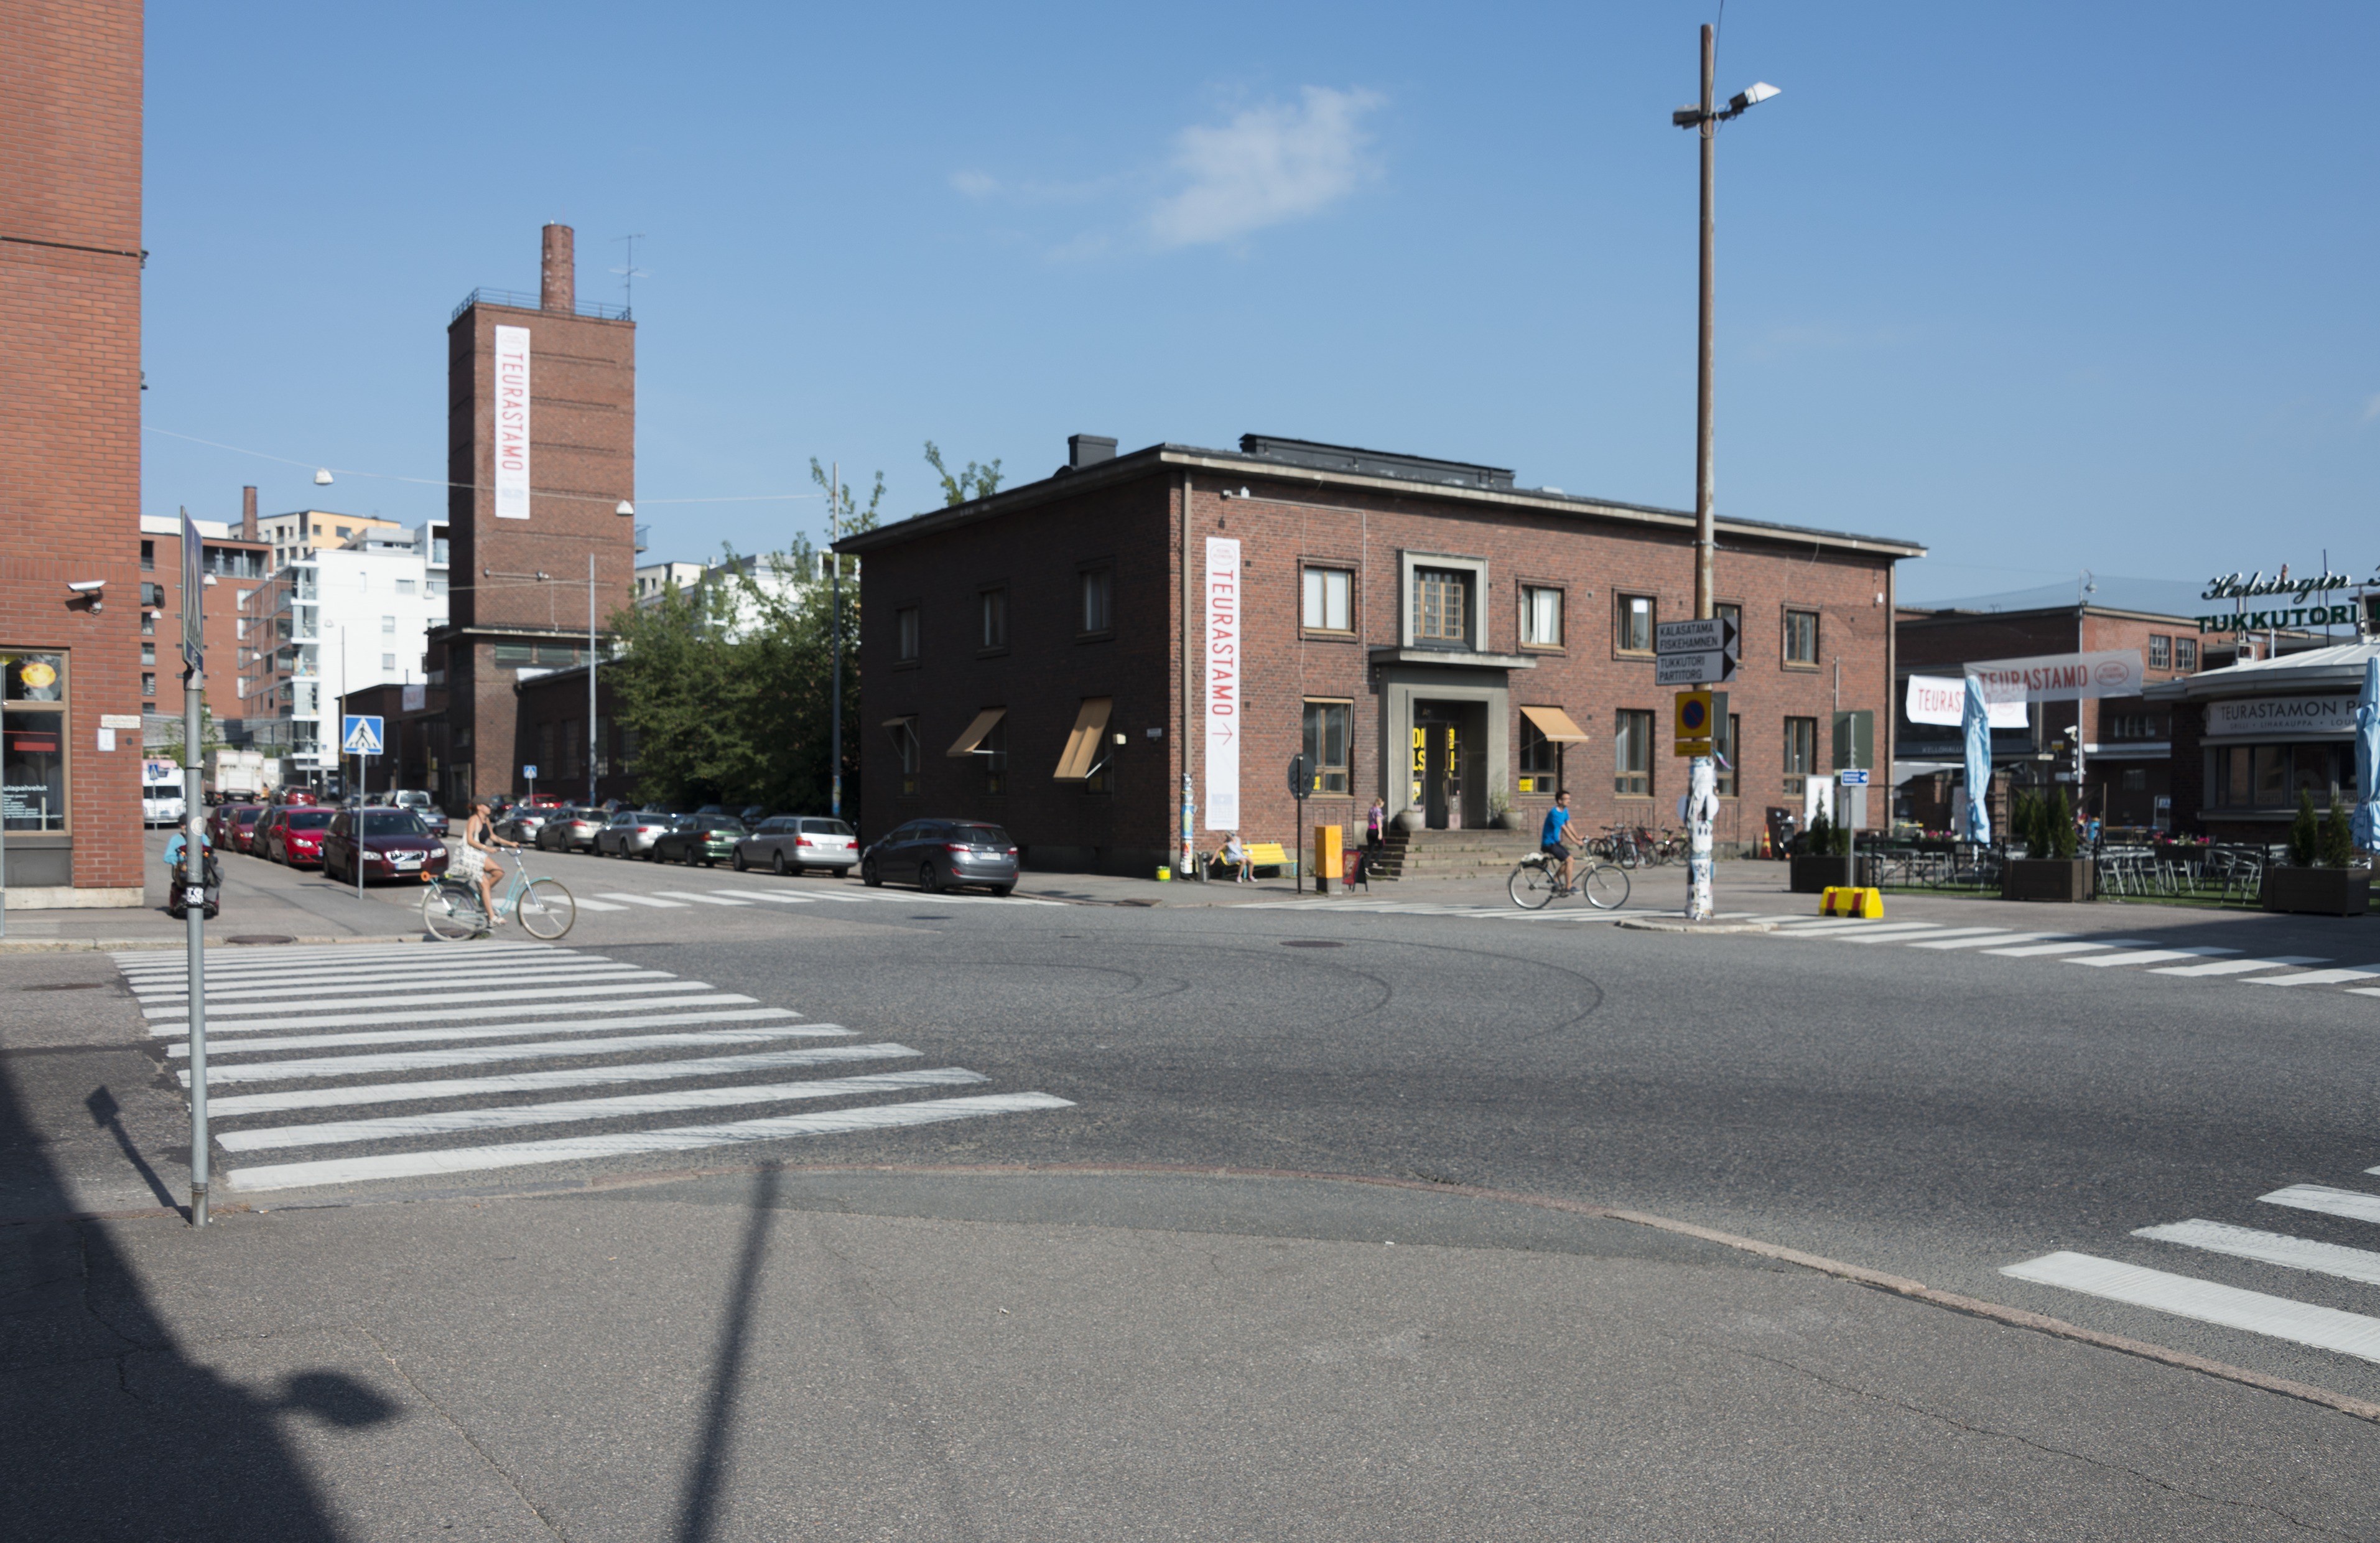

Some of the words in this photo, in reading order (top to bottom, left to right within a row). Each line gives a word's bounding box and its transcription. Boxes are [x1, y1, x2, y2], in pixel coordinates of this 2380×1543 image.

[502, 353, 524, 471] TEURASTAMO
[2201, 571, 2351, 604] Helsingin
[2195, 604, 2357, 634] TUKKUTORI
[1660, 623, 1713, 637] KALASATAMA
[1212, 570, 1234, 716] TEURASTAMO
[1660, 636, 1718, 650] FISKEHAMNEN
[1660, 655, 1705, 668] TUKKUTORI
[1659, 669, 1703, 682] PARTITORG
[1979, 664, 2088, 694] TEURASTAMO
[2221, 701, 2336, 720] TEURASTAMON
[2261, 720, 2313, 729] LIHAKAUPPA
